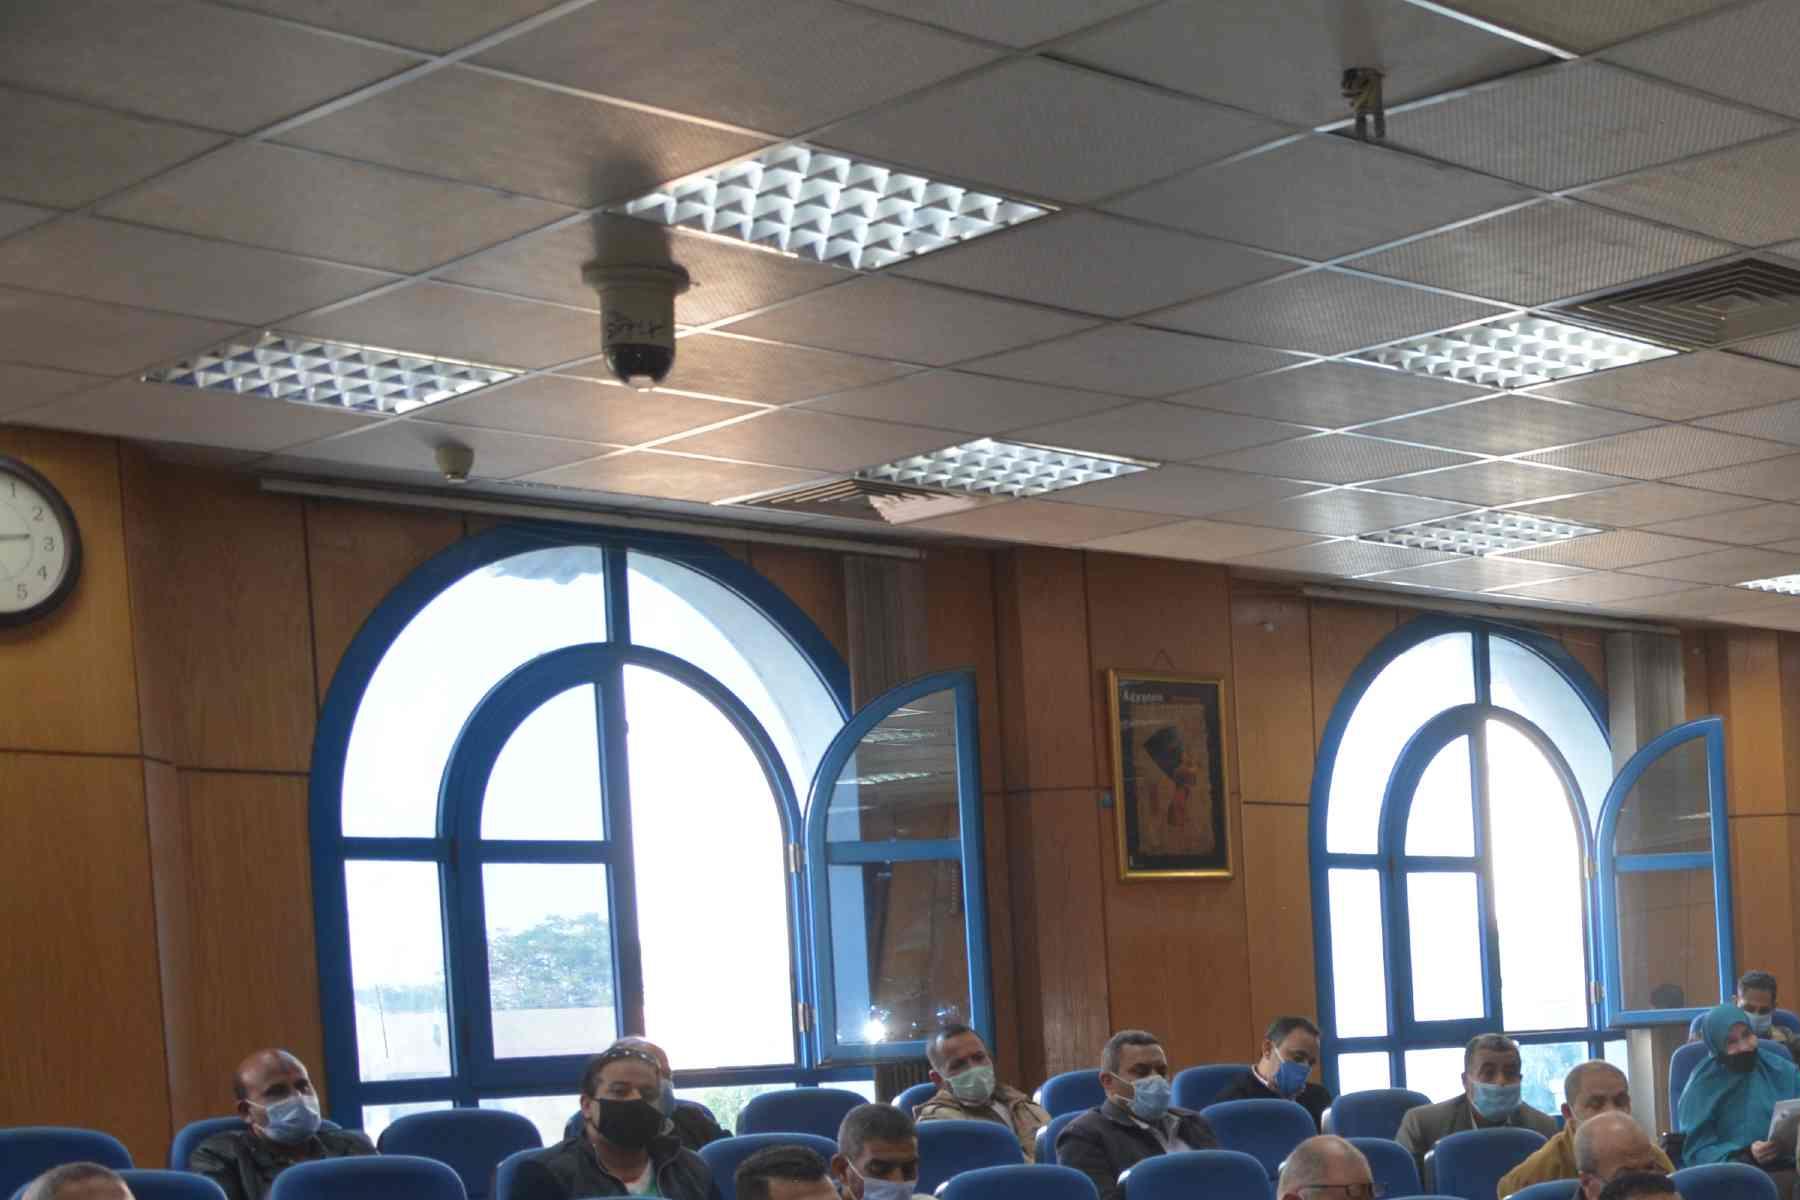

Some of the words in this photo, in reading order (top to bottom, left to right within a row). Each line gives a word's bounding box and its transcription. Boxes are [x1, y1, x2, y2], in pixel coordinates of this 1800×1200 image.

[10, 482, 16, 498] 1
[31, 505, 44, 521] 2
[43, 536, 56, 552] 3
[37, 565, 48, 580] 4
[16, 583, 28, 600] 5
